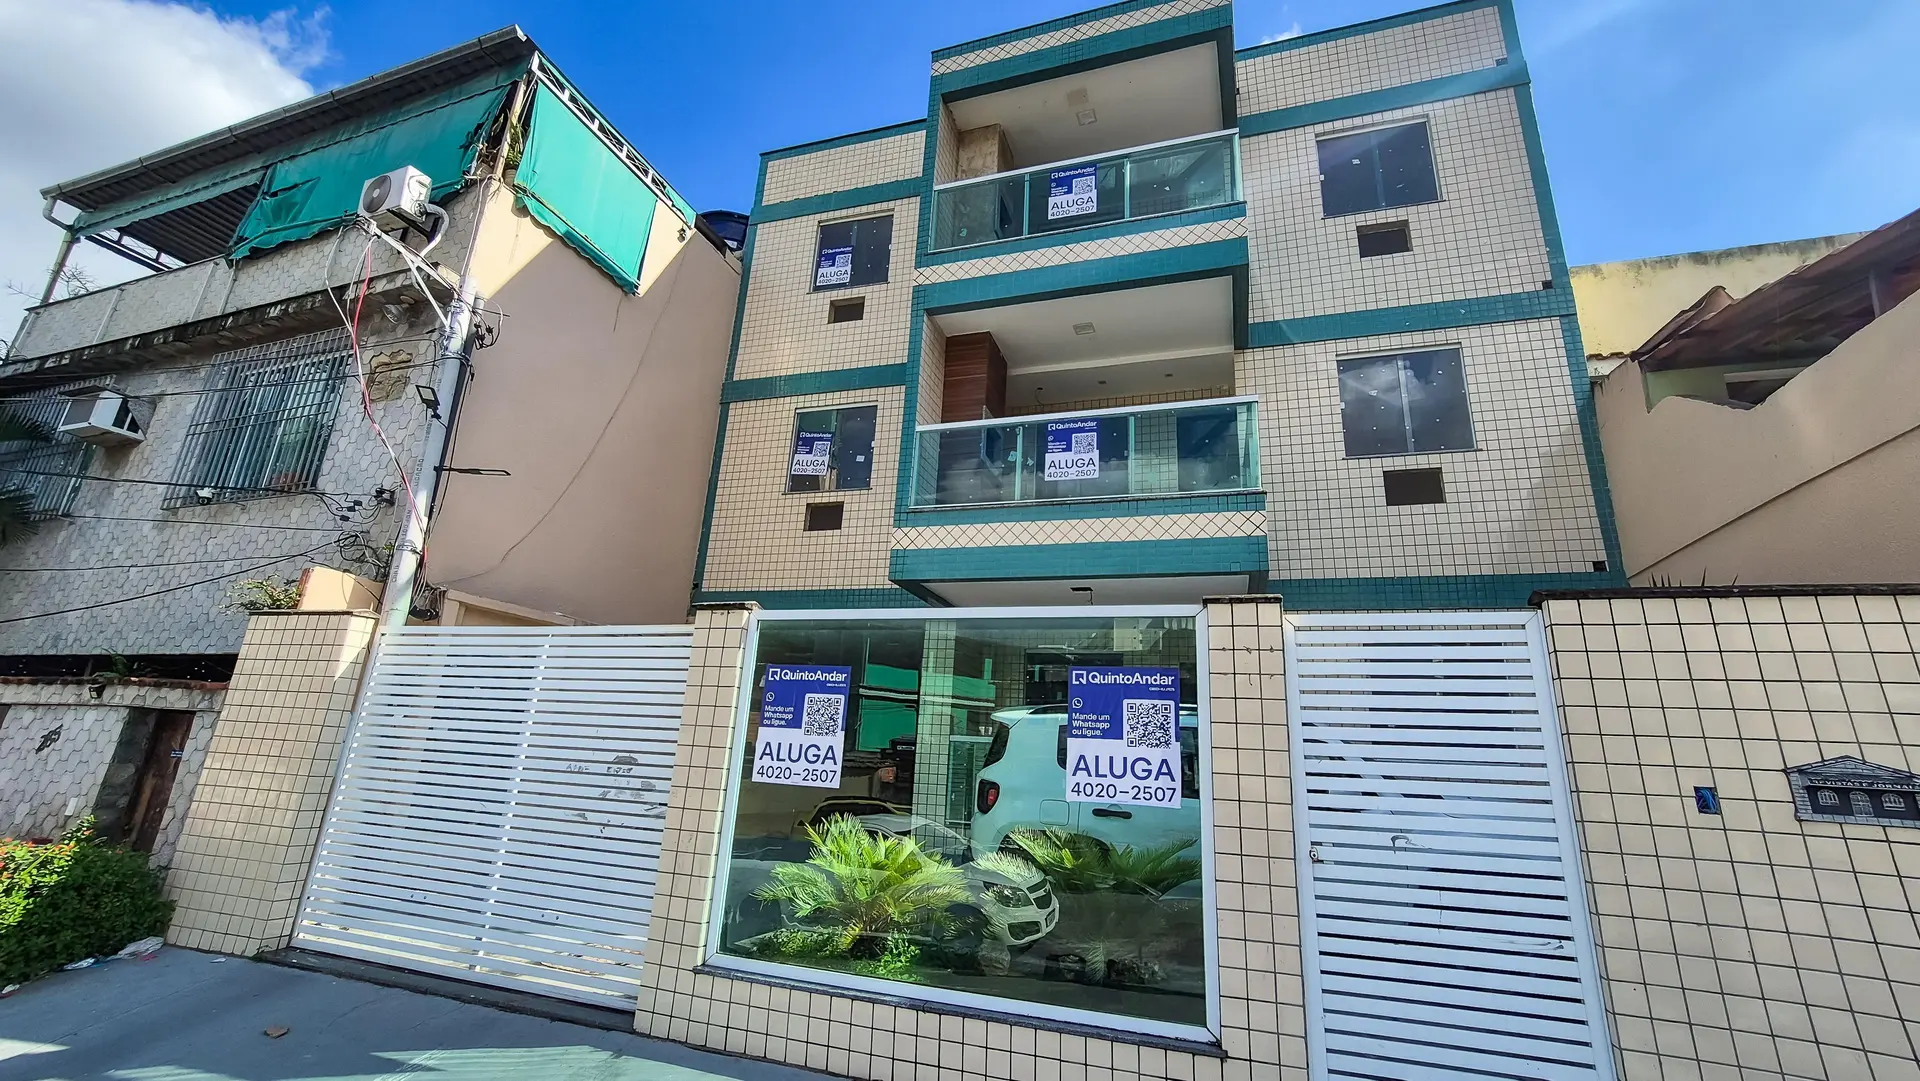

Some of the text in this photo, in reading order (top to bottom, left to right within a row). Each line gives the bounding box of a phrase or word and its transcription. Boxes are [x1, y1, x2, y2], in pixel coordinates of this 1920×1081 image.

[1051, 196, 1094, 210] ALUGA
[1051, 205, 1094, 216] 4020-2507
[819, 270, 848, 278] ALUGA
[1056, 421, 1097, 429] QuintoAndar
[1048, 458, 1095, 470] ALUGA
[1047, 469, 1096, 478] 4020-2507
[781, 669, 847, 682] QuintoAndar
[1088, 672, 1174, 685] QuintoAndar
[764, 712, 793, 720] Whatsapp
[1072, 720, 1110, 729] Whatsapp
[1082, 728, 1102, 736] ligue.
[758, 741, 838, 766] ALUGA
[757, 765, 837, 783] 4020-2507
[1072, 754, 1176, 782] ALUGA
[1071, 782, 1177, 802] 4020-2507
